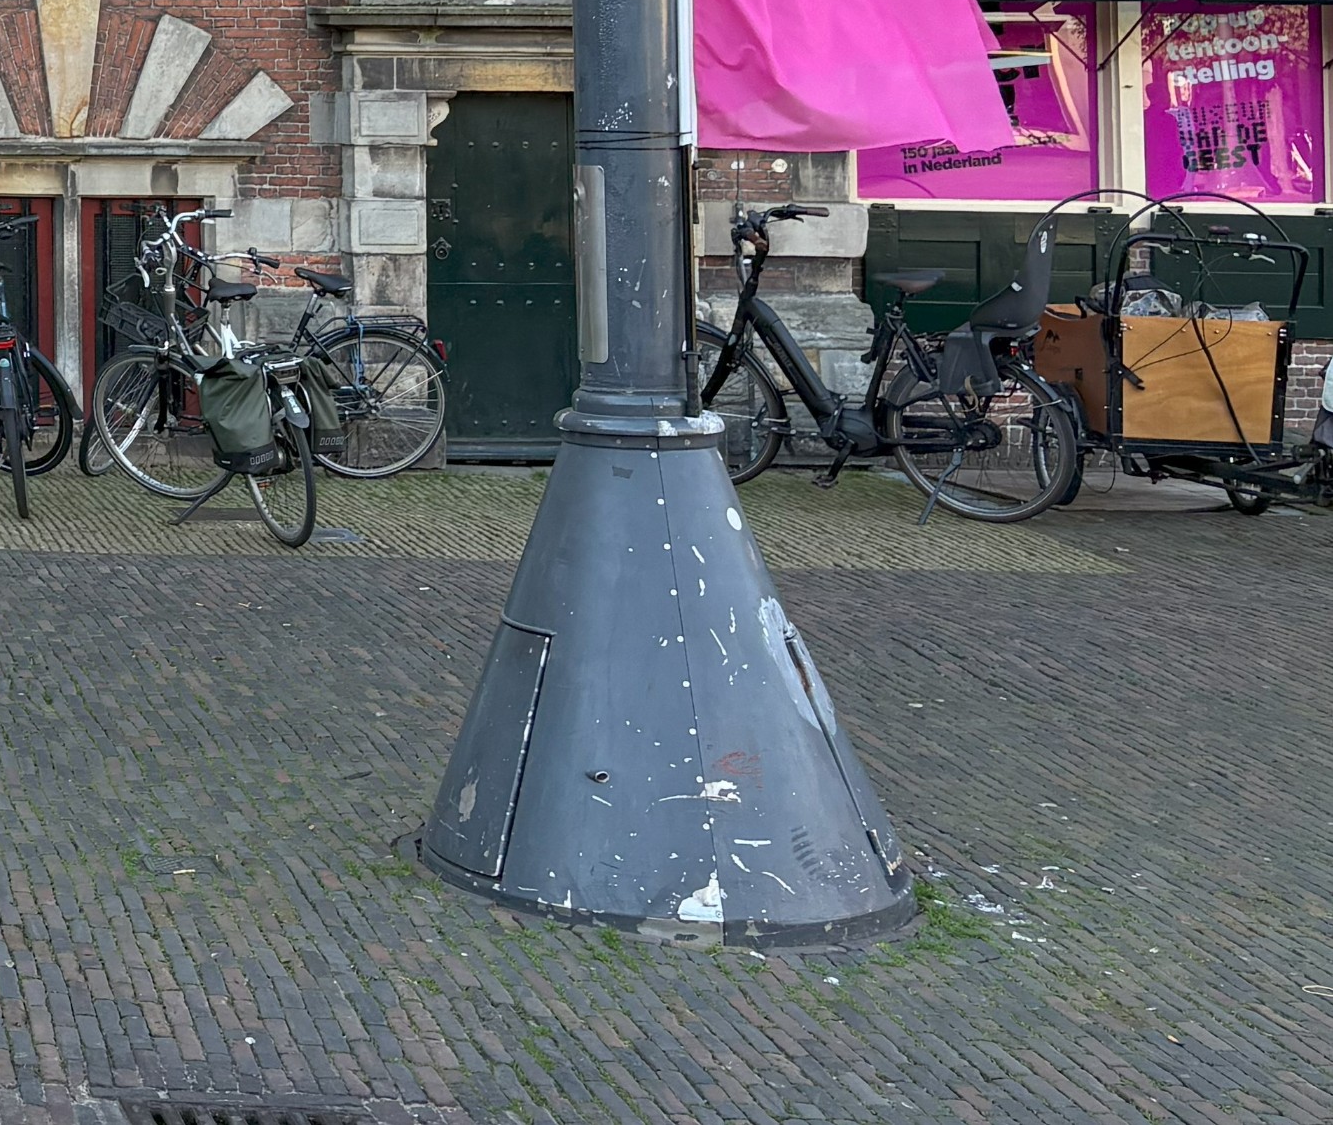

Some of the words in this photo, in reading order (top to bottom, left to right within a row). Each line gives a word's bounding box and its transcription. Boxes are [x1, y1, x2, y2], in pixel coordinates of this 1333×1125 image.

[1166, 32, 1289, 62] tentoon-
[1172, 58, 1276, 88] stelling
[1236, 121, 1268, 145] DE
[900, 146, 929, 160] 150
[903, 161, 919, 175] in
[921, 151, 1003, 174] Nederland
[1183, 143, 1262, 173] GEEST
